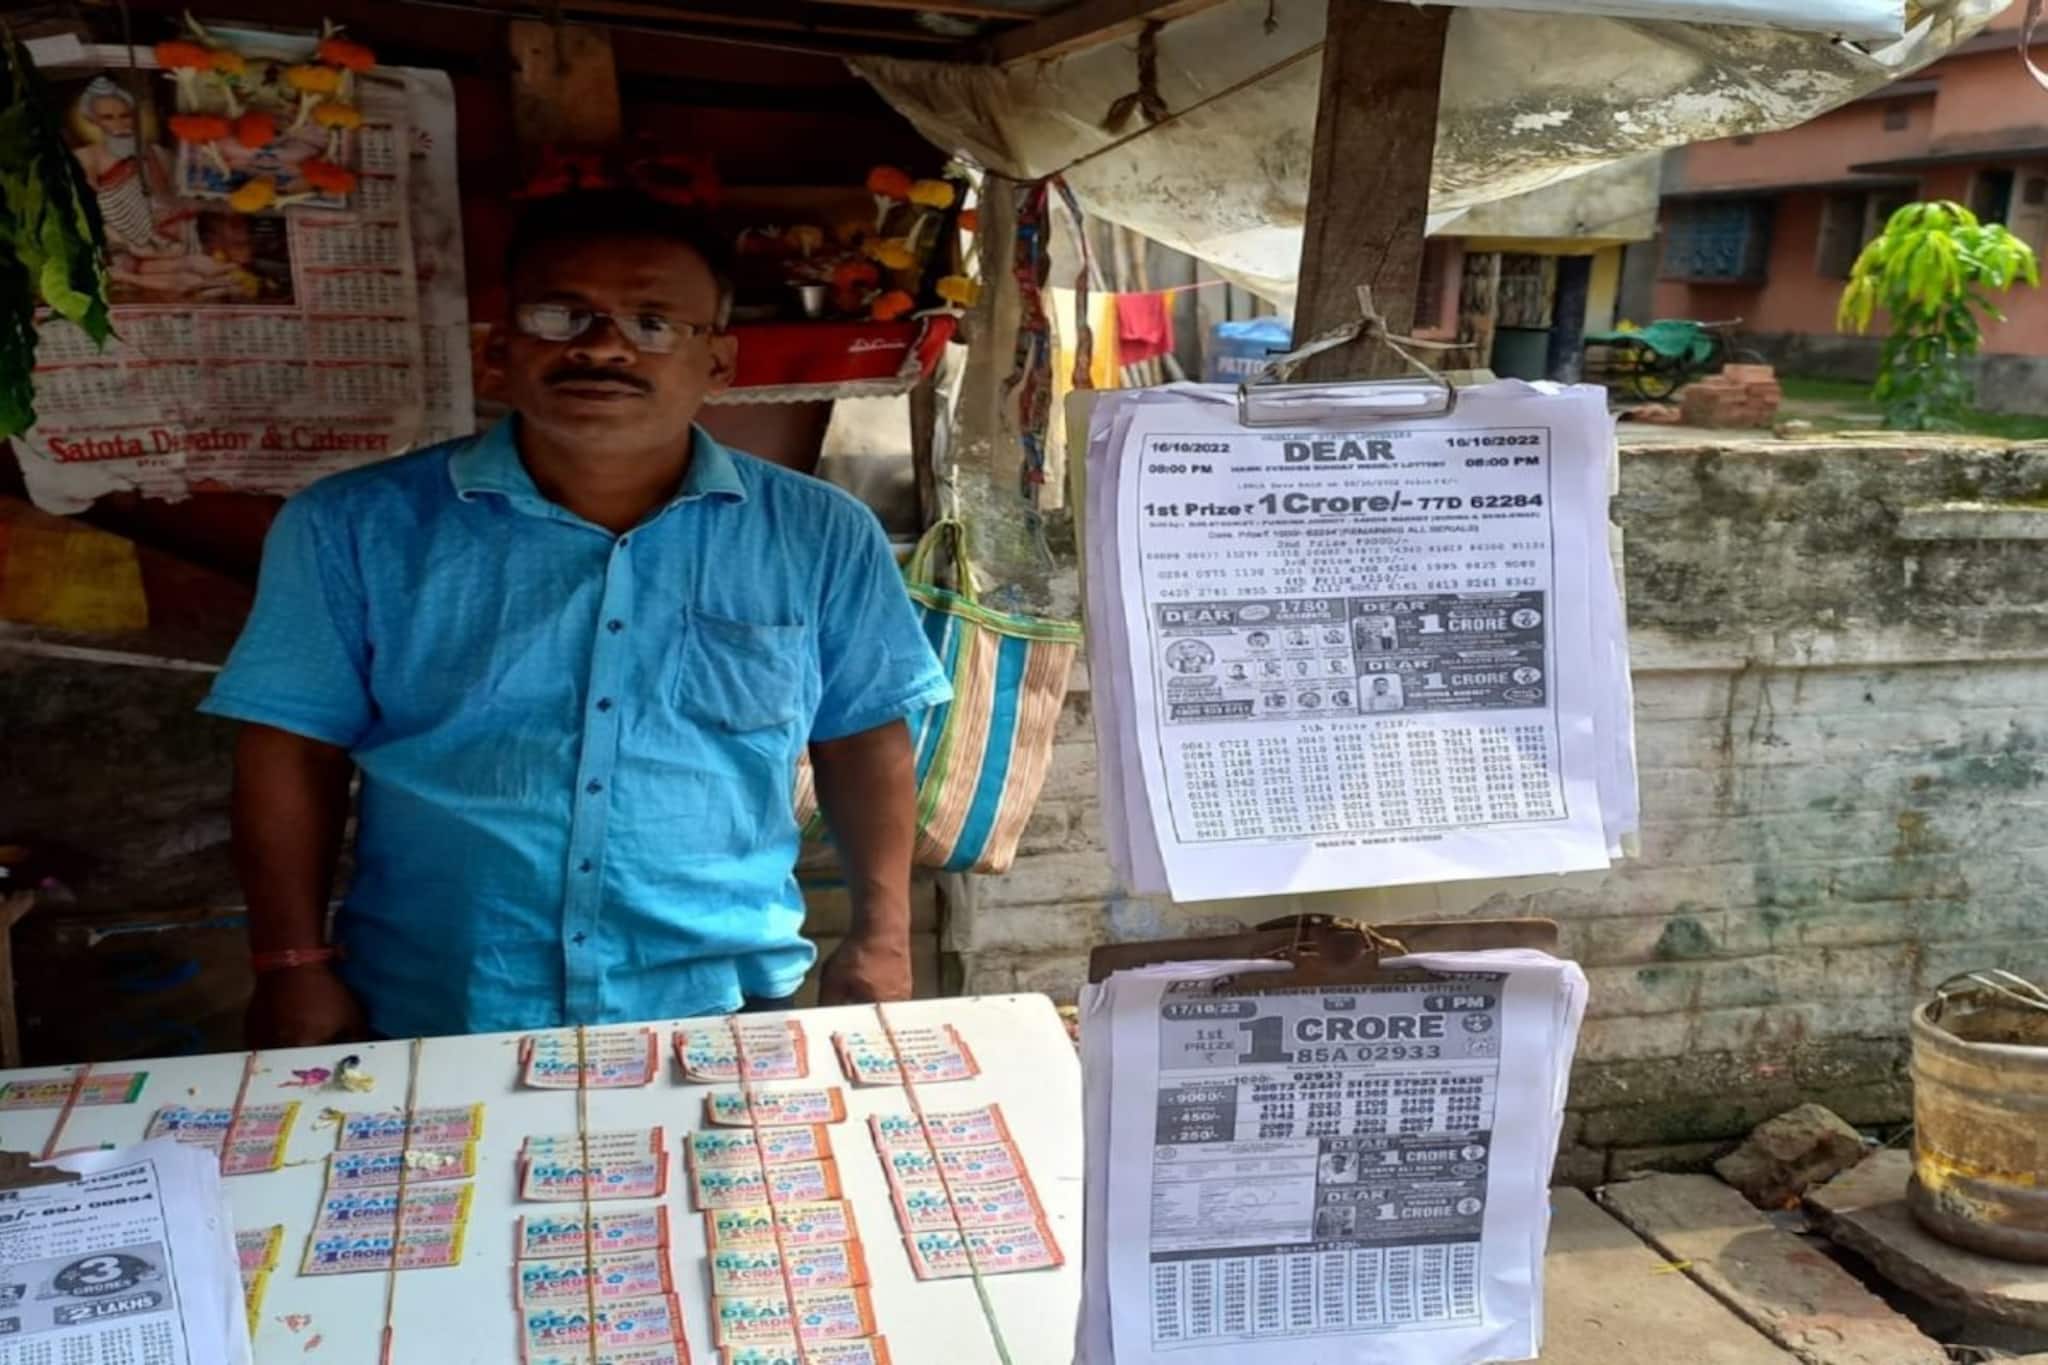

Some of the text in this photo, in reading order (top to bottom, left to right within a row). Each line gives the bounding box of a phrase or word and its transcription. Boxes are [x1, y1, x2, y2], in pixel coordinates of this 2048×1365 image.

[1283, 440, 1395, 463] DEAR
[1191, 464, 1213, 473] PM
[1514, 456, 1540, 466] PM
[1145, 504, 1179, 517] 1st
[1418, 496, 1462, 510] 77D
[1470, 494, 1543, 509] 62284
[1363, 601, 1426, 612] DEAR
[1165, 609, 1233, 622] DEAR
[1419, 614, 1508, 634] 1 CRORE
[1423, 672, 1509, 689] 1 CRORE
[1435, 996, 1485, 1009] 1 PM
[1296, 1015, 1444, 1042] CRORE
[1238, 1016, 1294, 1064] 1
[1297, 1045, 1441, 1063] 85A 02933
[1378, 1150, 1458, 1165] 1 CRORE
[1376, 1203, 1399, 1220] 1
[1401, 1206, 1452, 1218] CRORE
[77, 1256, 123, 1284] 3
[96, 1297, 153, 1316] LAKHS
